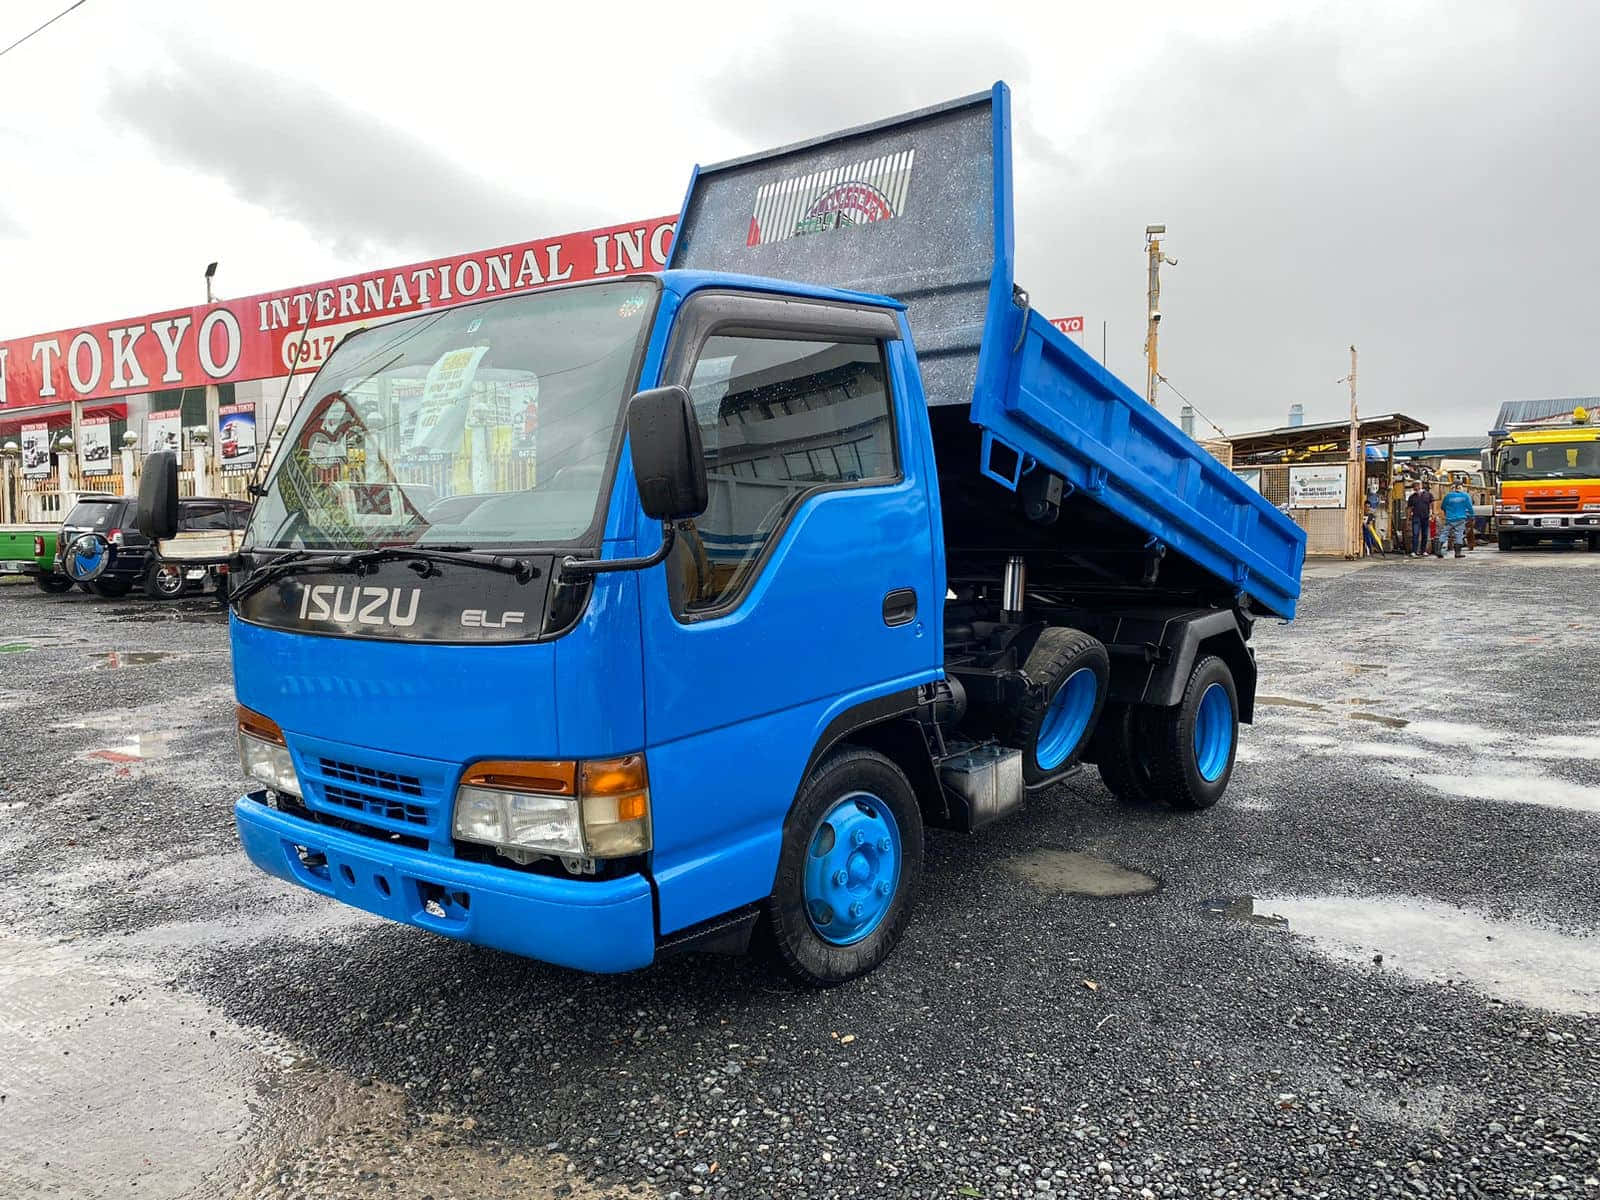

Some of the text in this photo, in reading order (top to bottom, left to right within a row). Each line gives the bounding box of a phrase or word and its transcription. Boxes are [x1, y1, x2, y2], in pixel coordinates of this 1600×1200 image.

[31, 307, 241, 397] TOKYO
[258, 244, 573, 332] INTERNATIONAL
[593, 222, 677, 275] INC
[286, 334, 335, 364] 0917
[299, 584, 421, 627] ISUZU
[460, 609, 525, 628] ELF
